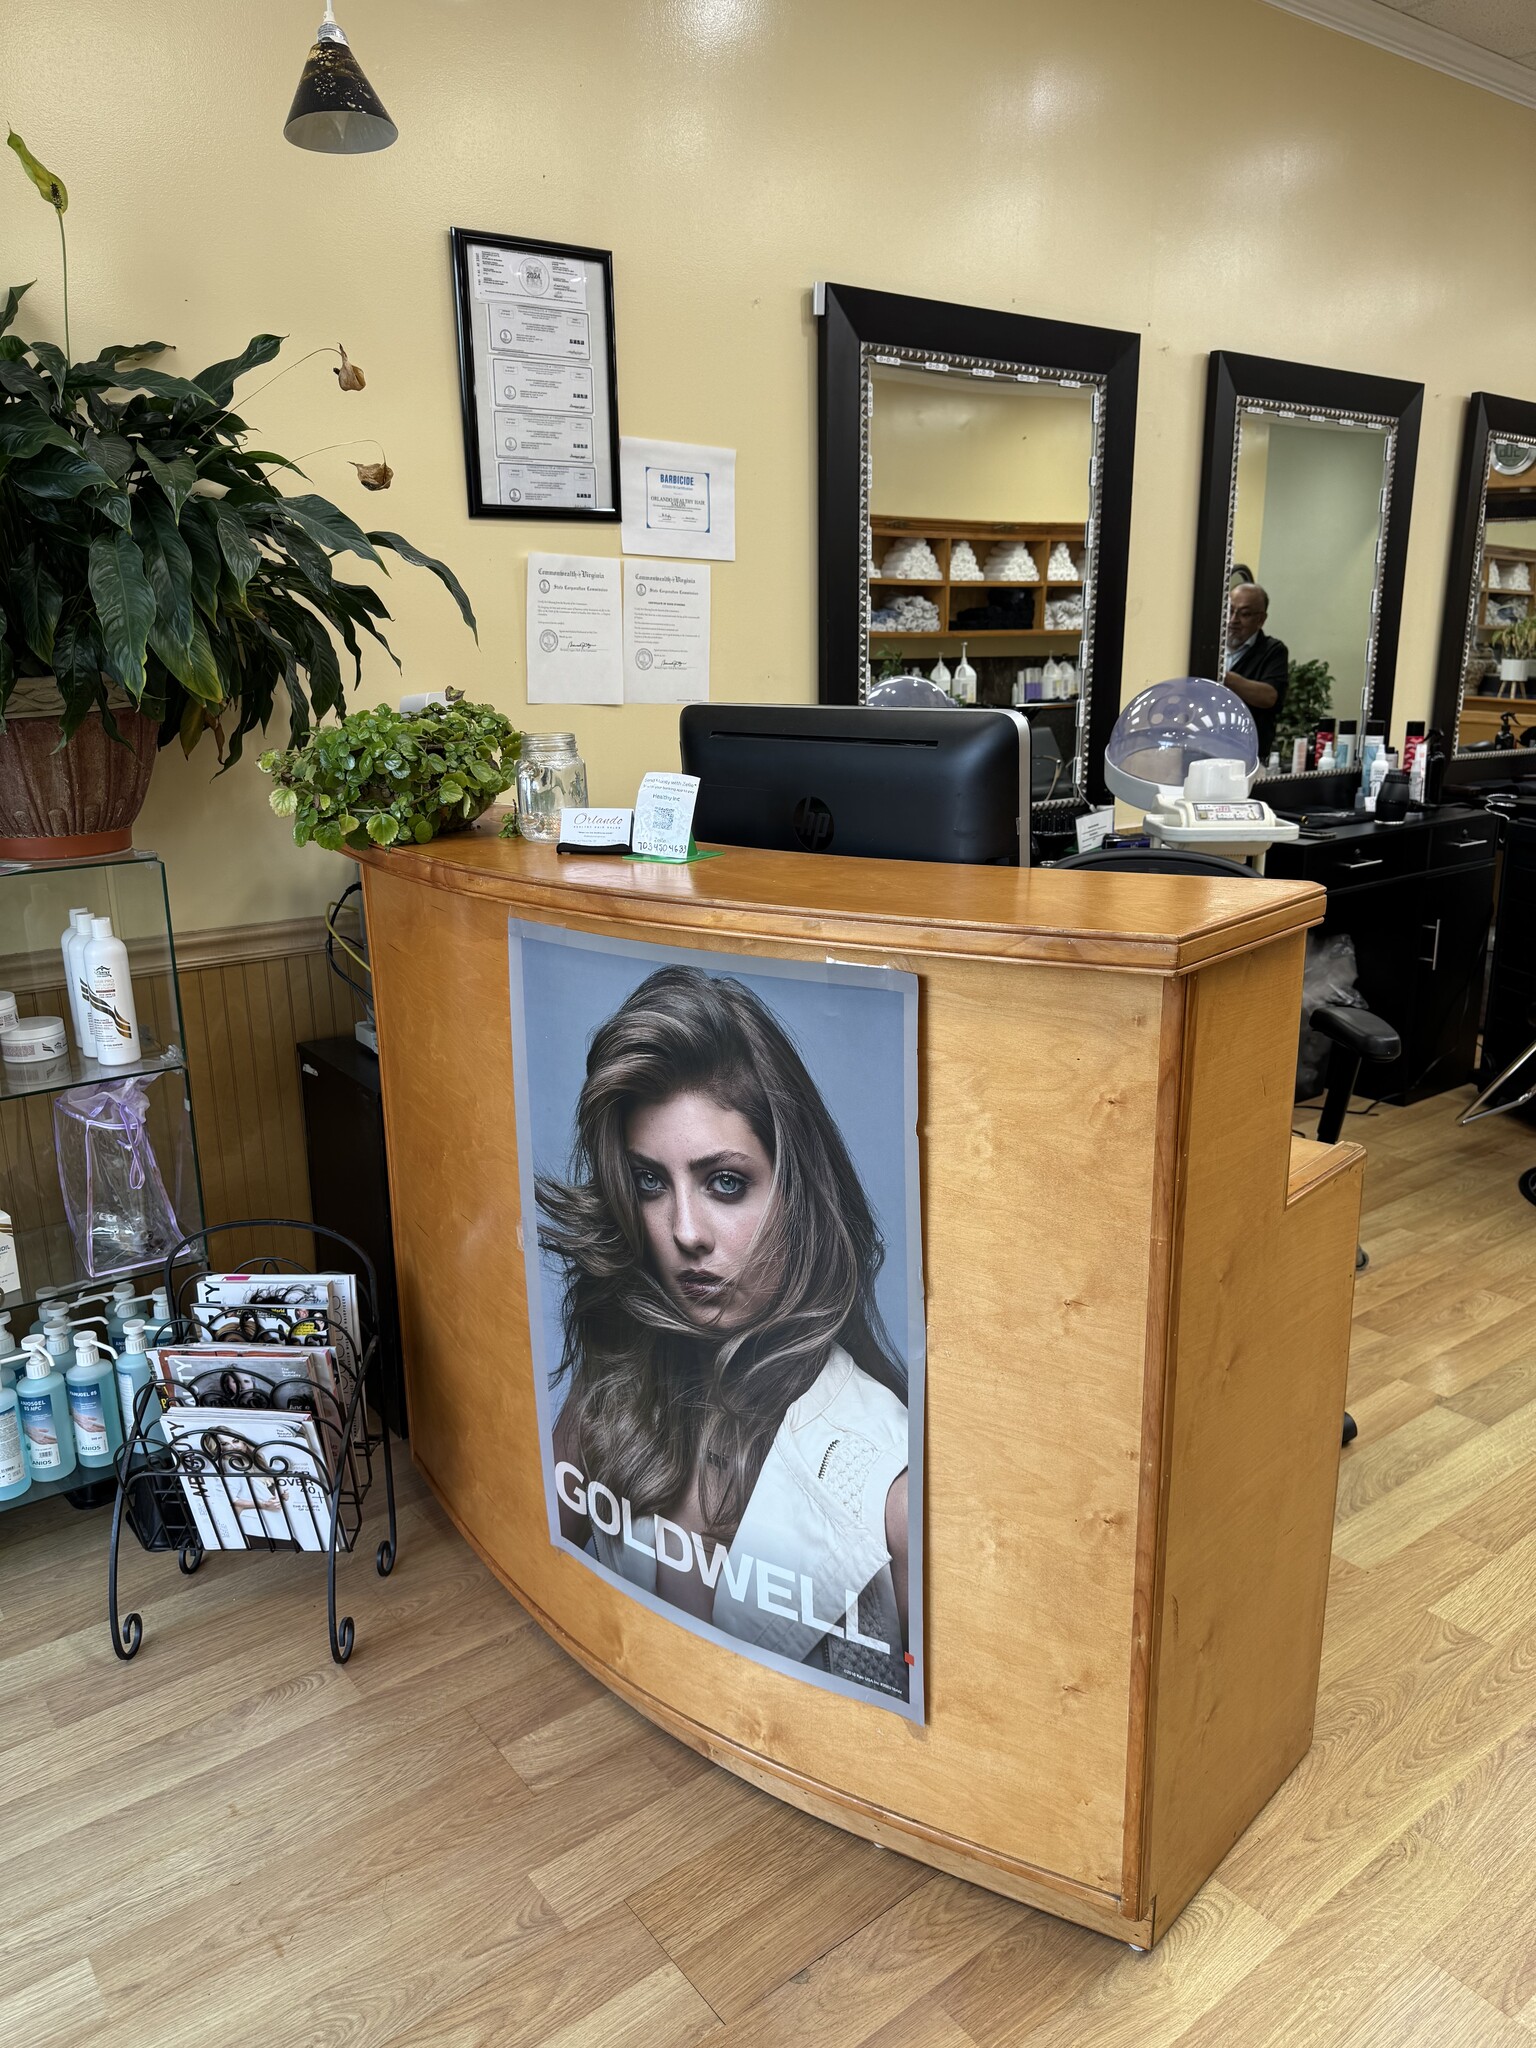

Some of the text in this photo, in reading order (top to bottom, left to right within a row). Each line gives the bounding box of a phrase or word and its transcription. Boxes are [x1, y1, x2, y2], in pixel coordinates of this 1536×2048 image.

[526, 271, 541, 280] 2024
[660, 473, 695, 486] BARBICIDE
[650, 495, 672, 503] ORLANDO
[537, 567, 577, 579] Commonwealth
[581, 569, 605, 580] Virginia
[675, 575, 696, 585] Virginia
[652, 793, 672, 802] Healthy
[573, 812, 623, 825] Orlando
[803, 796, 832, 850] hp
[277, 1478, 314, 1487] OVER
[554, 1461, 891, 1656] GOLDWELL
